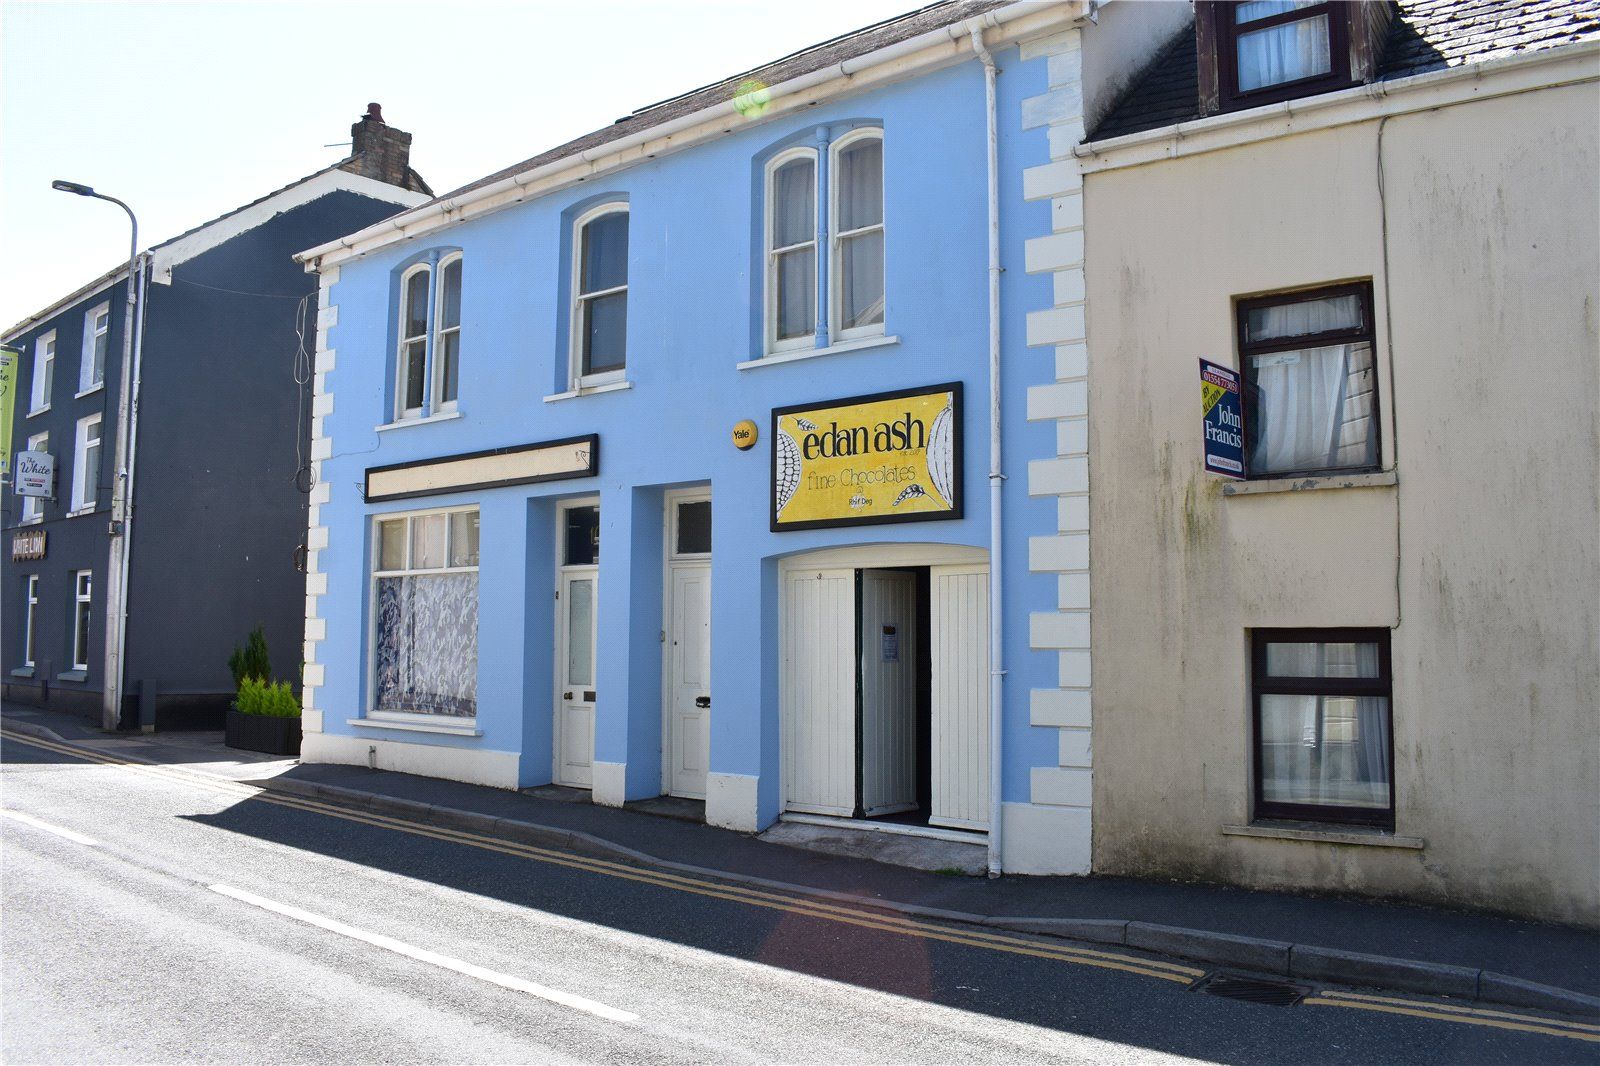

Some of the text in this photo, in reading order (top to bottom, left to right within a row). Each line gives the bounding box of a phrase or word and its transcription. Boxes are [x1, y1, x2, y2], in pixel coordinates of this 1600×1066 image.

[1218, 403, 1241, 429] John
[733, 429, 750, 440] Yale
[803, 412, 926, 460] edan ash
[1205, 419, 1242, 448] Francis
[20, 462, 51, 475] White
[807, 465, 916, 491] fine Chocolates
